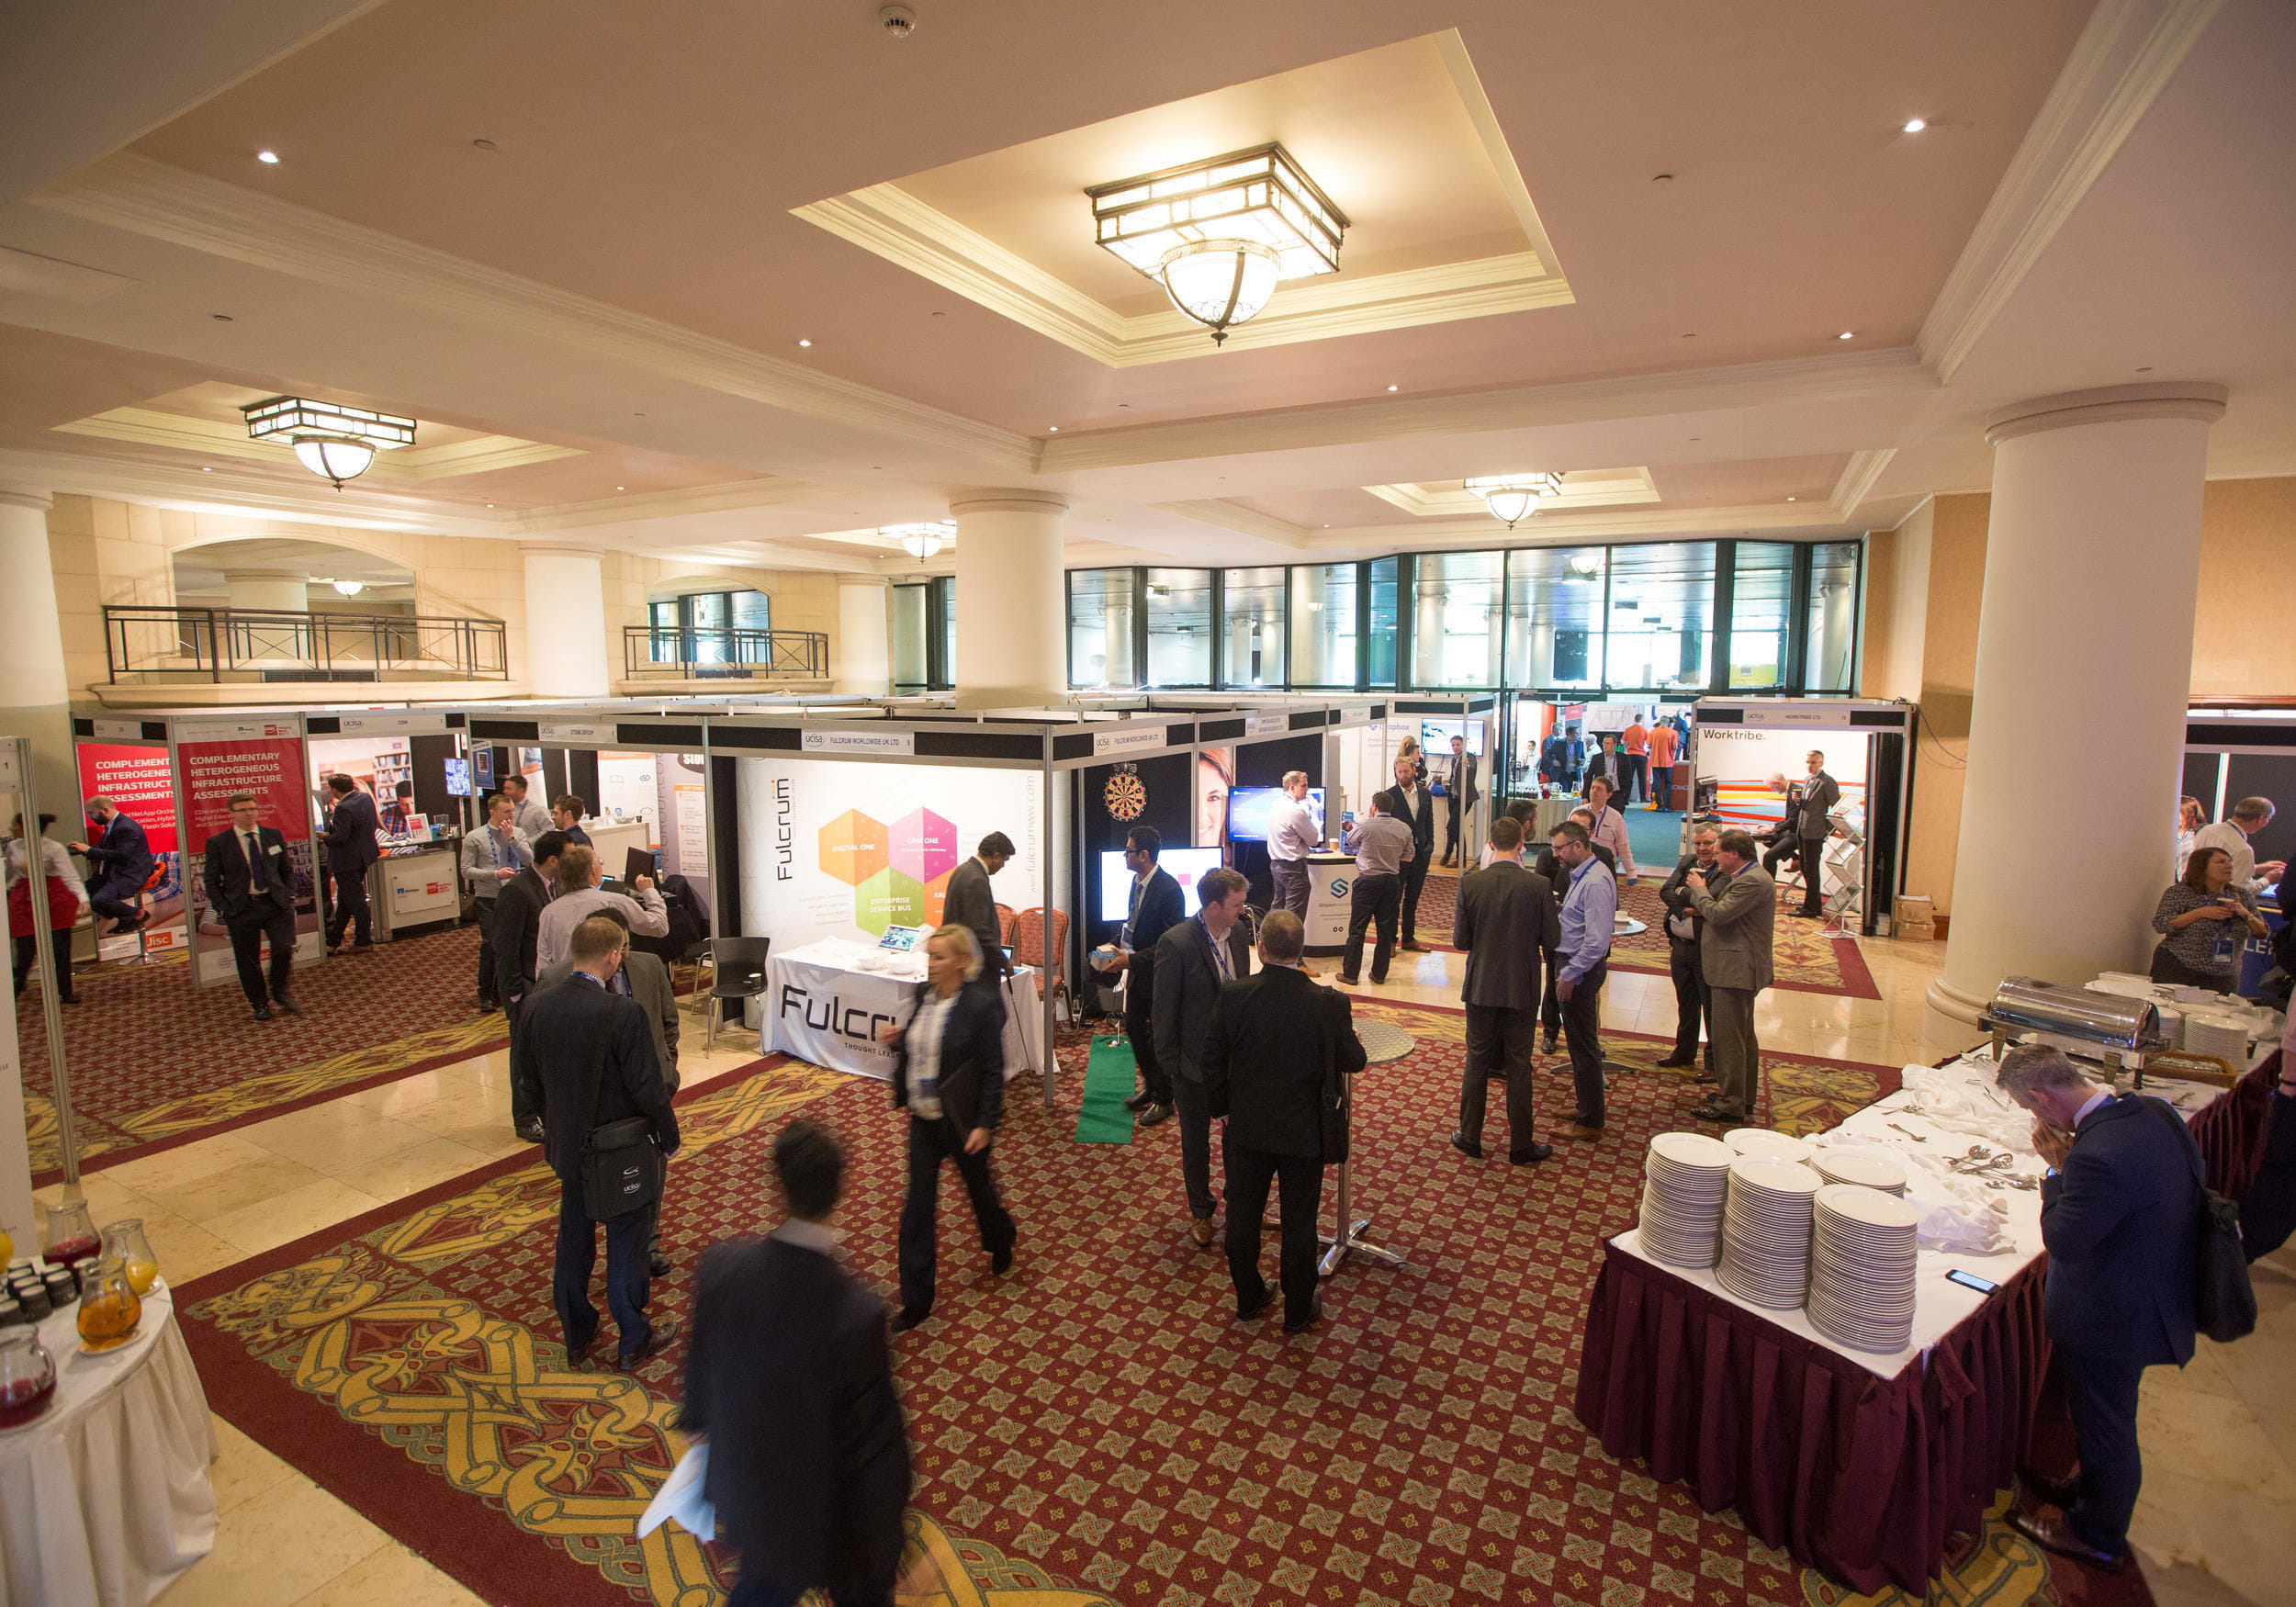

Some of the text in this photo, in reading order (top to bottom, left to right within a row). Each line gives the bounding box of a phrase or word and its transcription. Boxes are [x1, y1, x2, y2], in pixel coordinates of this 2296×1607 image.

[805, 734, 823, 743] ucisa
[1704, 729, 1766, 741] Worktribe.
[190, 753, 280, 765] COMPLEMENTARY
[190, 763, 280, 777] HETEROGENEOUS
[191, 774, 283, 789] INFRASTRUCTURE
[193, 786, 269, 801] ASSESSMENTS
[775, 779, 793, 881] Fulcrum
[860, 843, 875, 851] ONE
[871, 896, 910, 905] ENTERPRISE
[147, 934, 169, 947] Jisc
[782, 983, 896, 1042] Fulcr
[844, 1042, 876, 1054] THOUGHT
